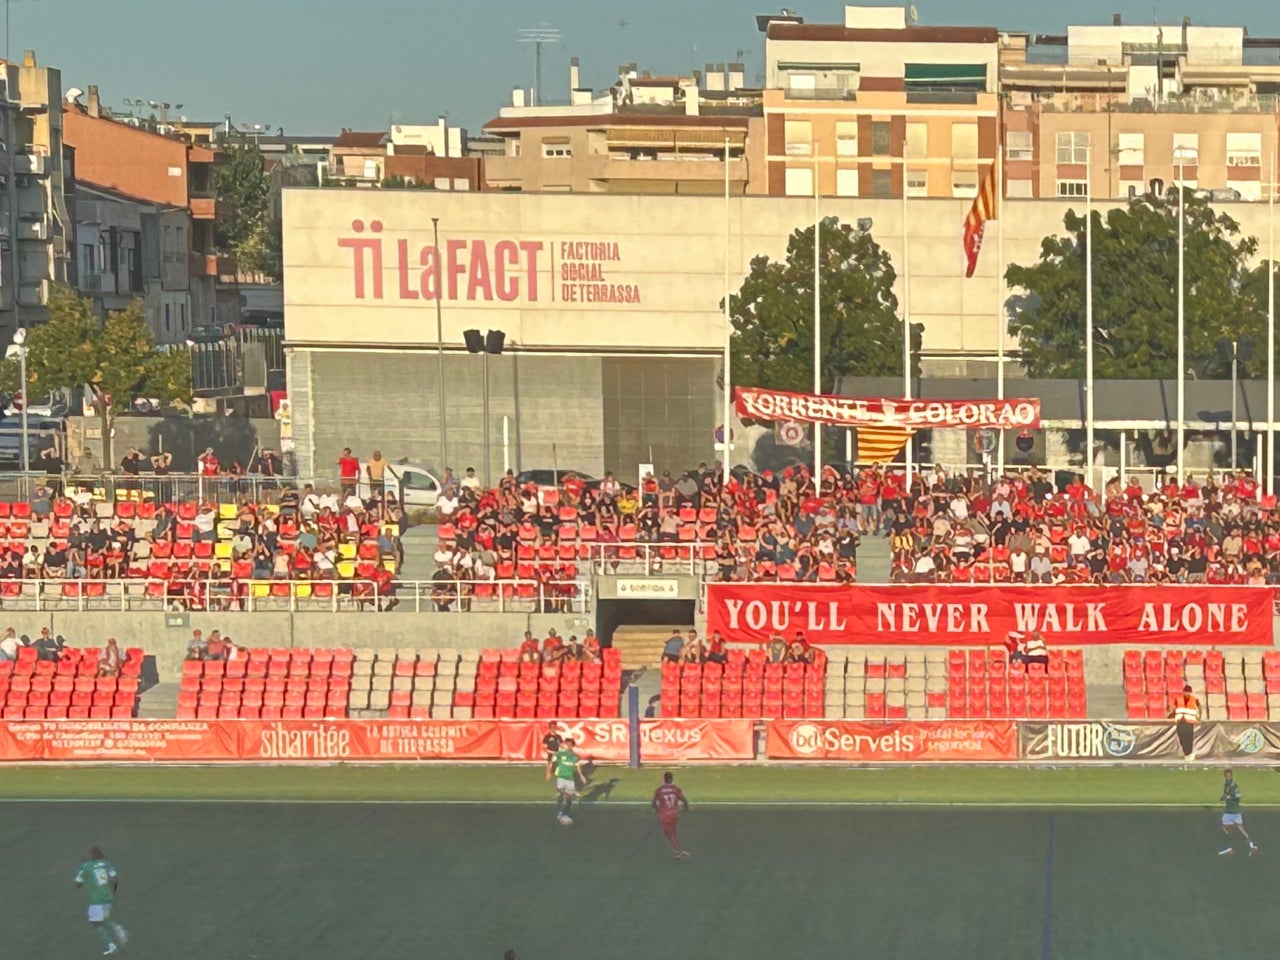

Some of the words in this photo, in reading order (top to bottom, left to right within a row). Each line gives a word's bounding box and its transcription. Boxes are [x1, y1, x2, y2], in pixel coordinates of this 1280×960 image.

[560, 241, 621, 261] FACTORIA
[561, 262, 606, 282] SOCIAL
[908, 401, 1035, 425] COLORAO
[724, 598, 847, 631] YOU'LL
[877, 601, 990, 633] NEVER
[1013, 602, 1108, 633] WALK
[1140, 602, 1249, 633] ALONE
[260, 722, 350, 758] sibaritée
[595, 723, 626, 743] SR
[825, 727, 914, 753] Serveis
